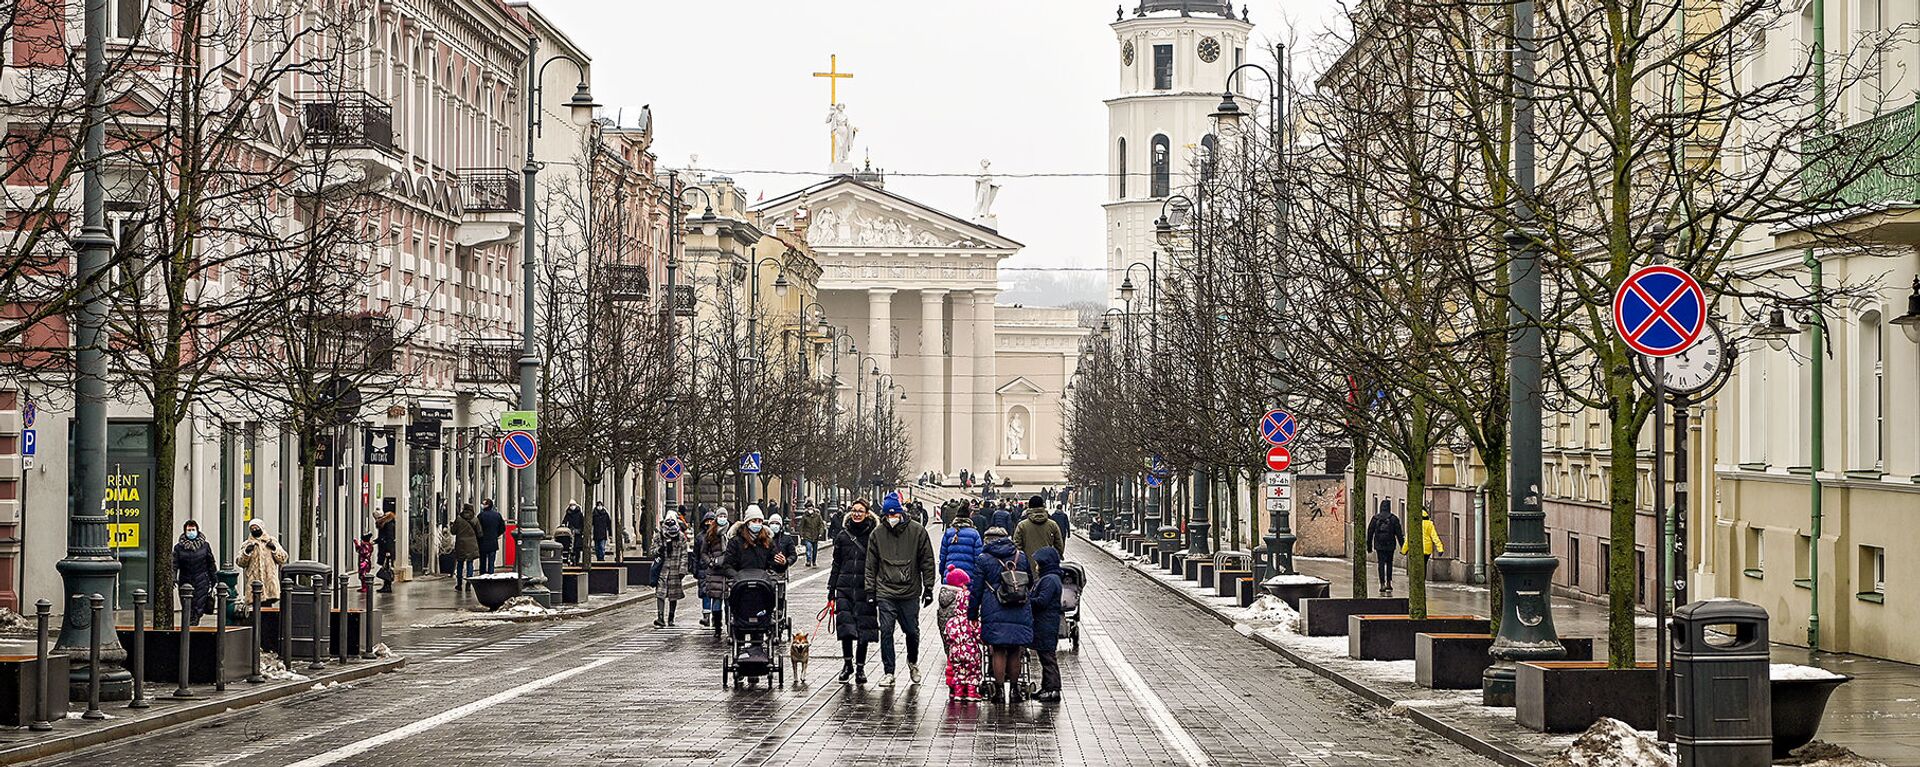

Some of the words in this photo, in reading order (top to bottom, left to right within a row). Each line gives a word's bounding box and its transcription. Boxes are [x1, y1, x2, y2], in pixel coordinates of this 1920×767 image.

[26, 432, 34, 453] P
[107, 474, 139, 486] RENT
[105, 488, 139, 501] OMA
[124, 508, 139, 517] 999
